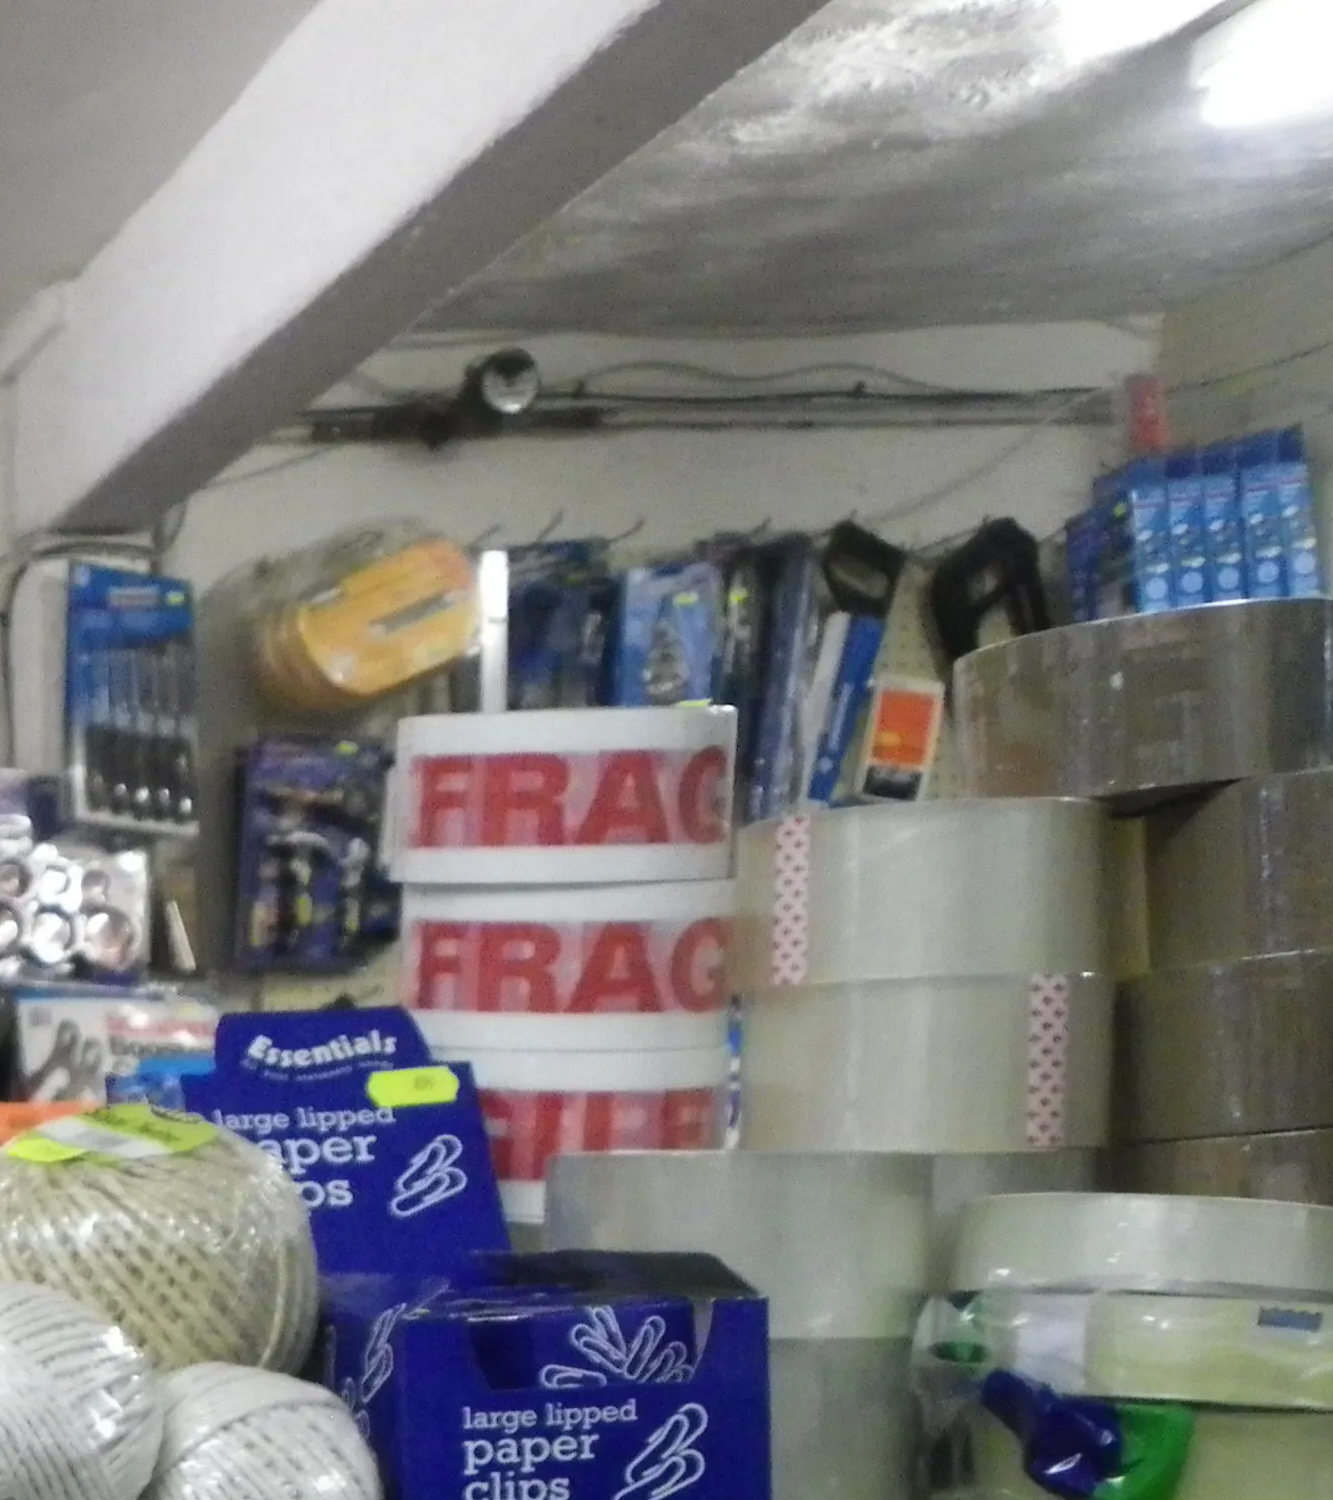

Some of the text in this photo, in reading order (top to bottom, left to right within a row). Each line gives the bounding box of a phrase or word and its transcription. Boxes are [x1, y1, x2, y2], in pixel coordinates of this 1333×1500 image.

[247, 1028, 398, 1068] Essentials
[296, 1105, 397, 1134] lipped
[462, 1399, 638, 1433] large lipped
[463, 1432, 600, 1477] paper
